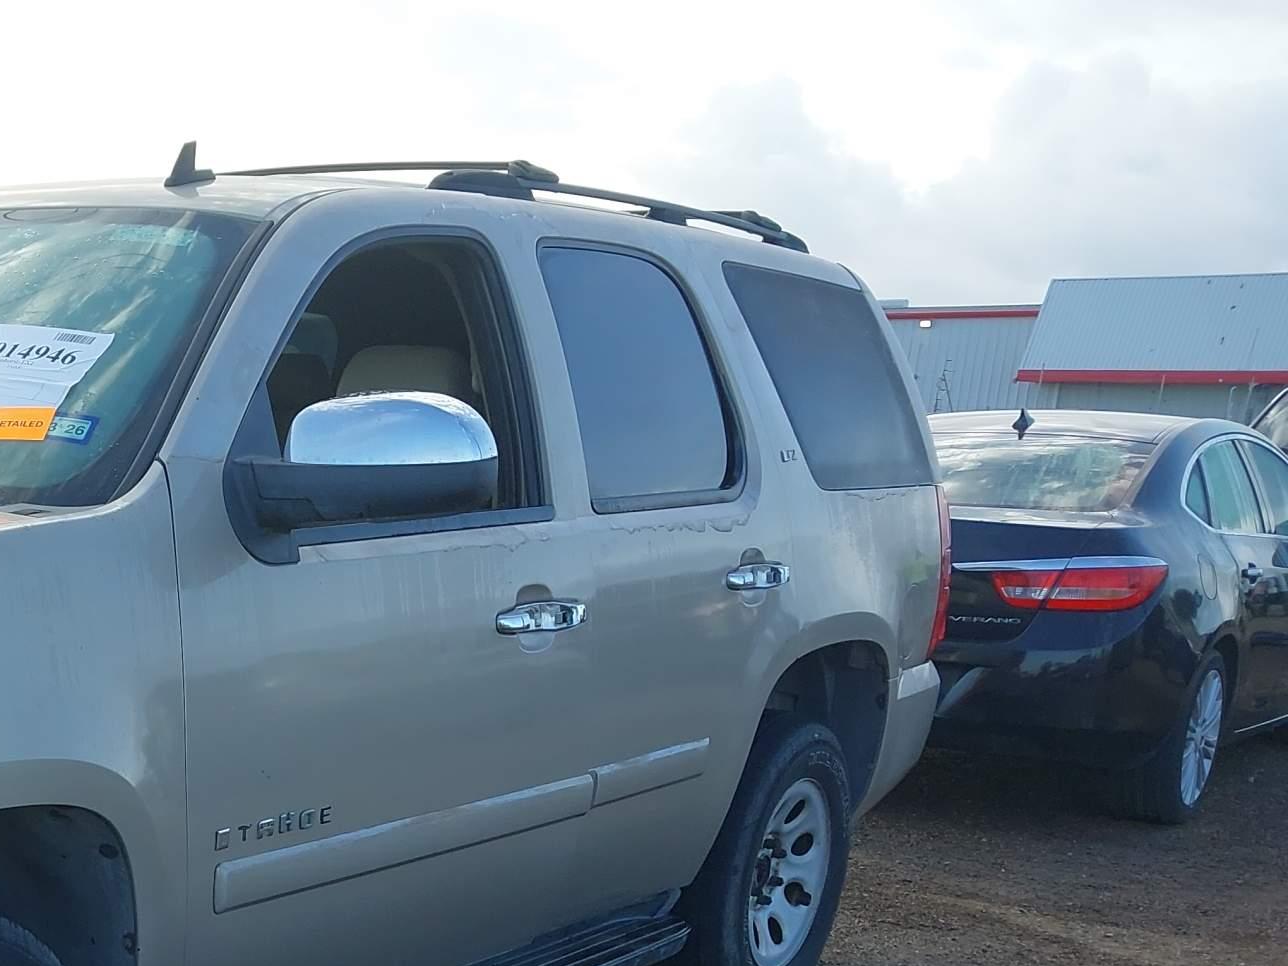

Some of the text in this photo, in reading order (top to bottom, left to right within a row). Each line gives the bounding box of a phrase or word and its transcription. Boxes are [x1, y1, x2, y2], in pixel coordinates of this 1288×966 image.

[64, 423, 86, 436] 26
[948, 614, 1022, 624] VERANO
[237, 805, 332, 842] TAHOE
